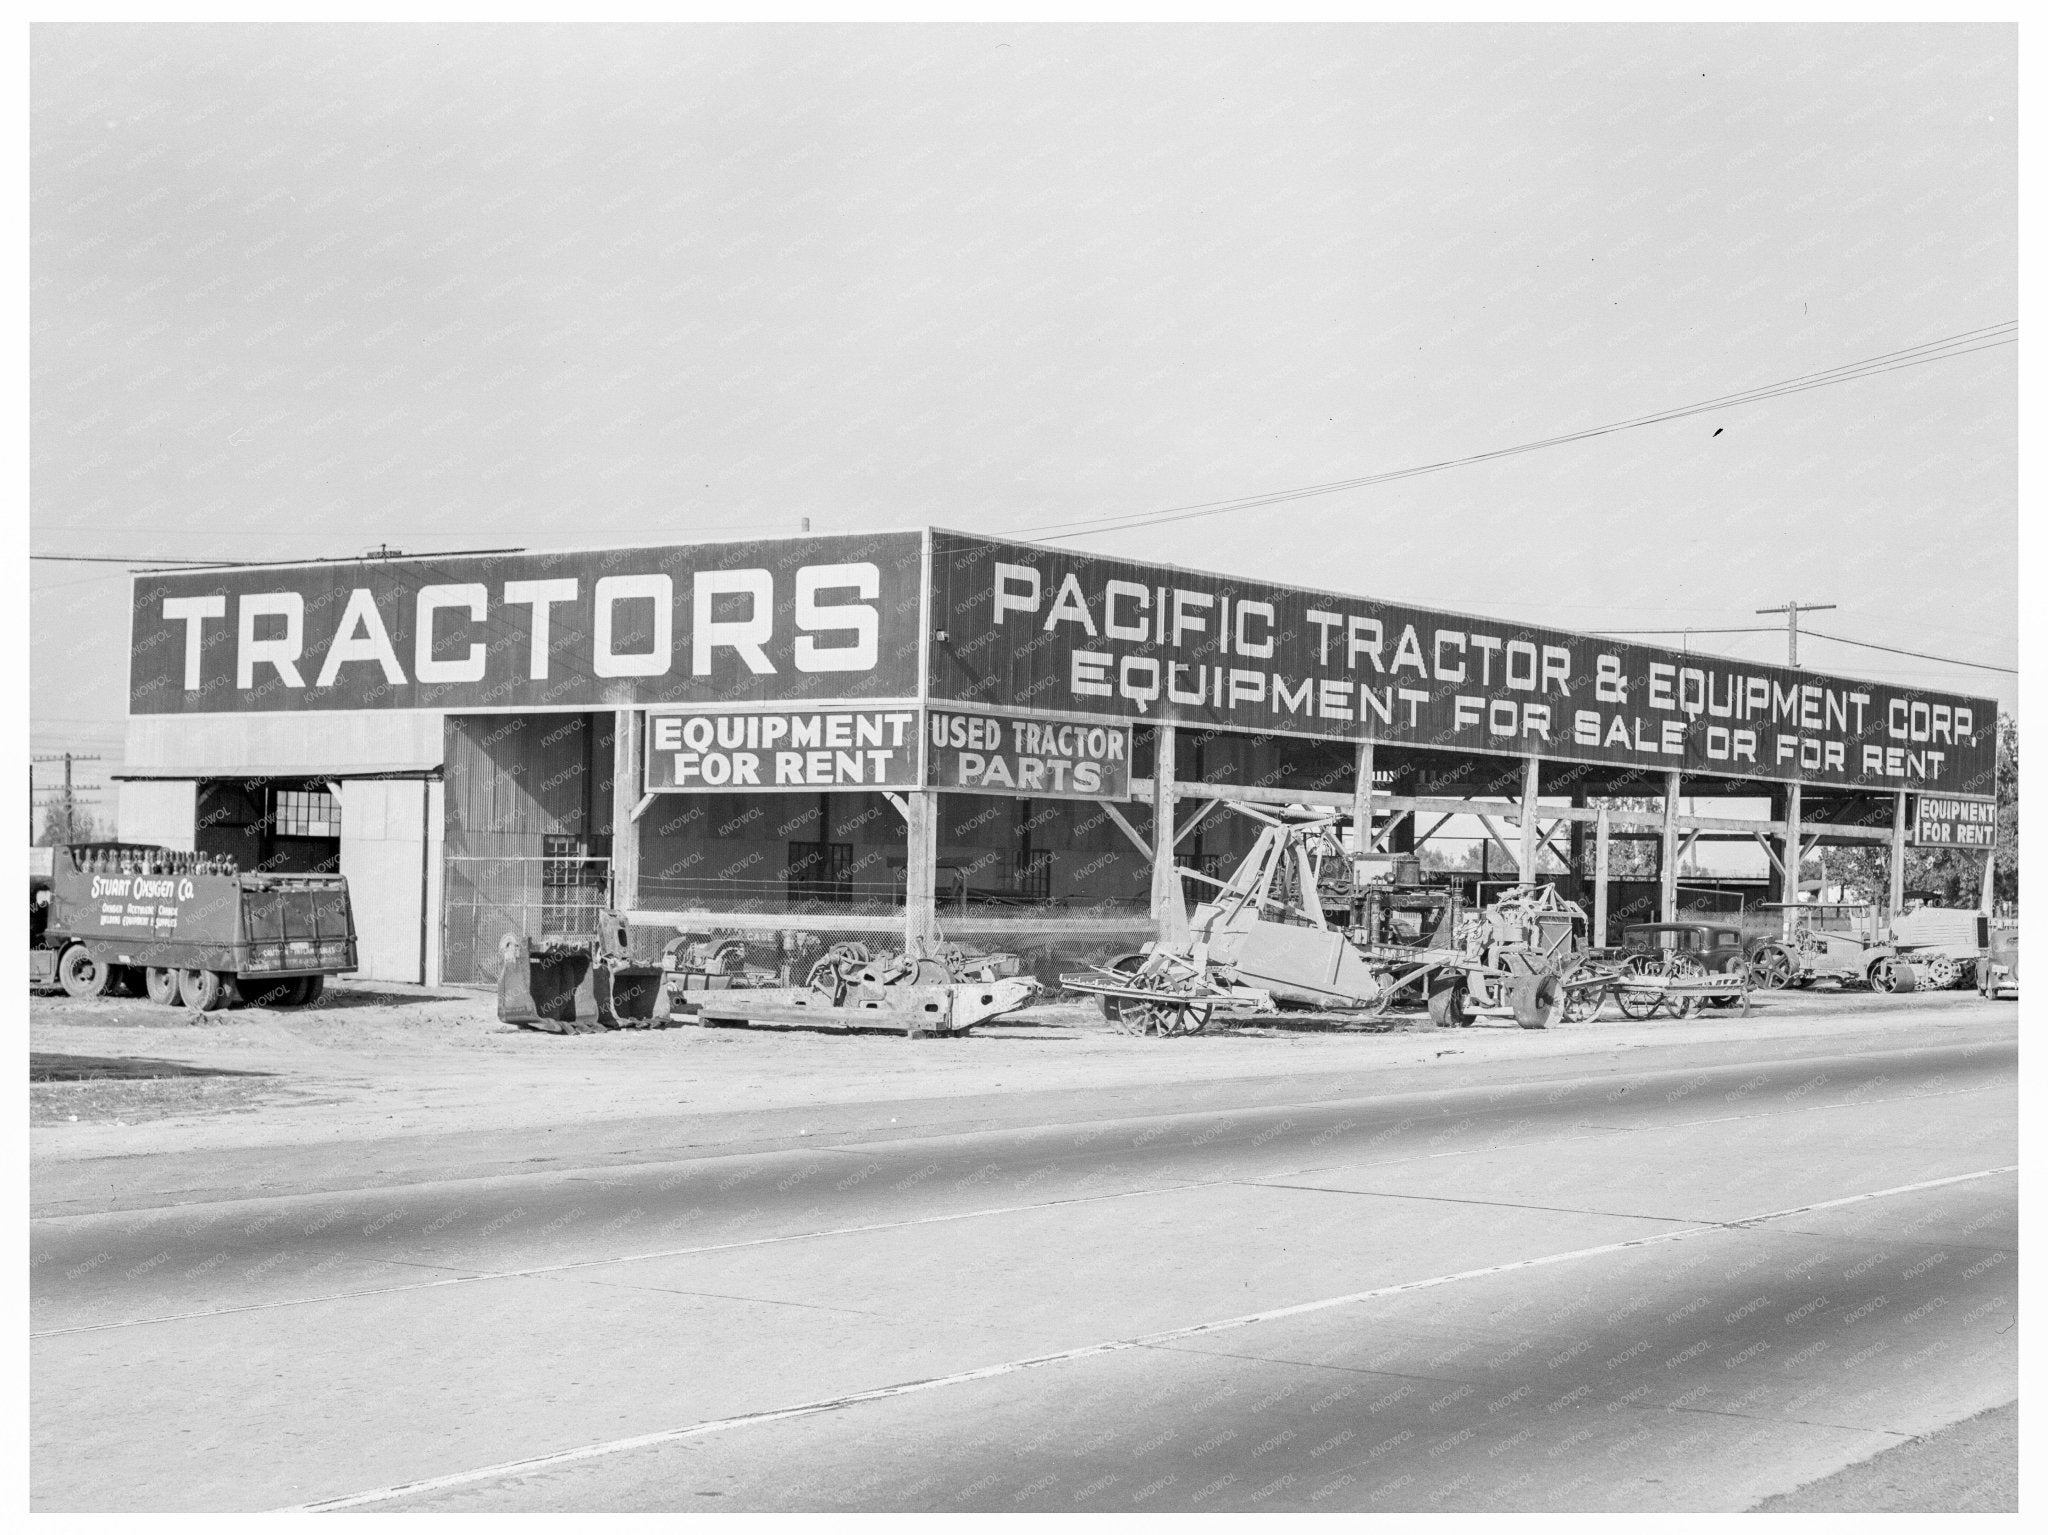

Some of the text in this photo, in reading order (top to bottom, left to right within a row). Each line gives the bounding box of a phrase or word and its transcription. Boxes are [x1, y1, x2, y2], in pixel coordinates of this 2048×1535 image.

[162, 561, 880, 691] TRACTORS
[994, 563, 1977, 748] PACIFIC TRACTOR & EQUIPMENT CORP.
[655, 713, 912, 753] EQUIPMENT
[1071, 650, 1945, 780] EQUIPMENT FOR SALE OR FOR RENT
[932, 714, 1124, 760] USED TRACTOR
[674, 750, 894, 786] FOR RENT
[958, 753, 1101, 793] PARTS
[1920, 798, 1995, 823] EQUIPMENT
[1922, 822, 1994, 845] FOR RENT
